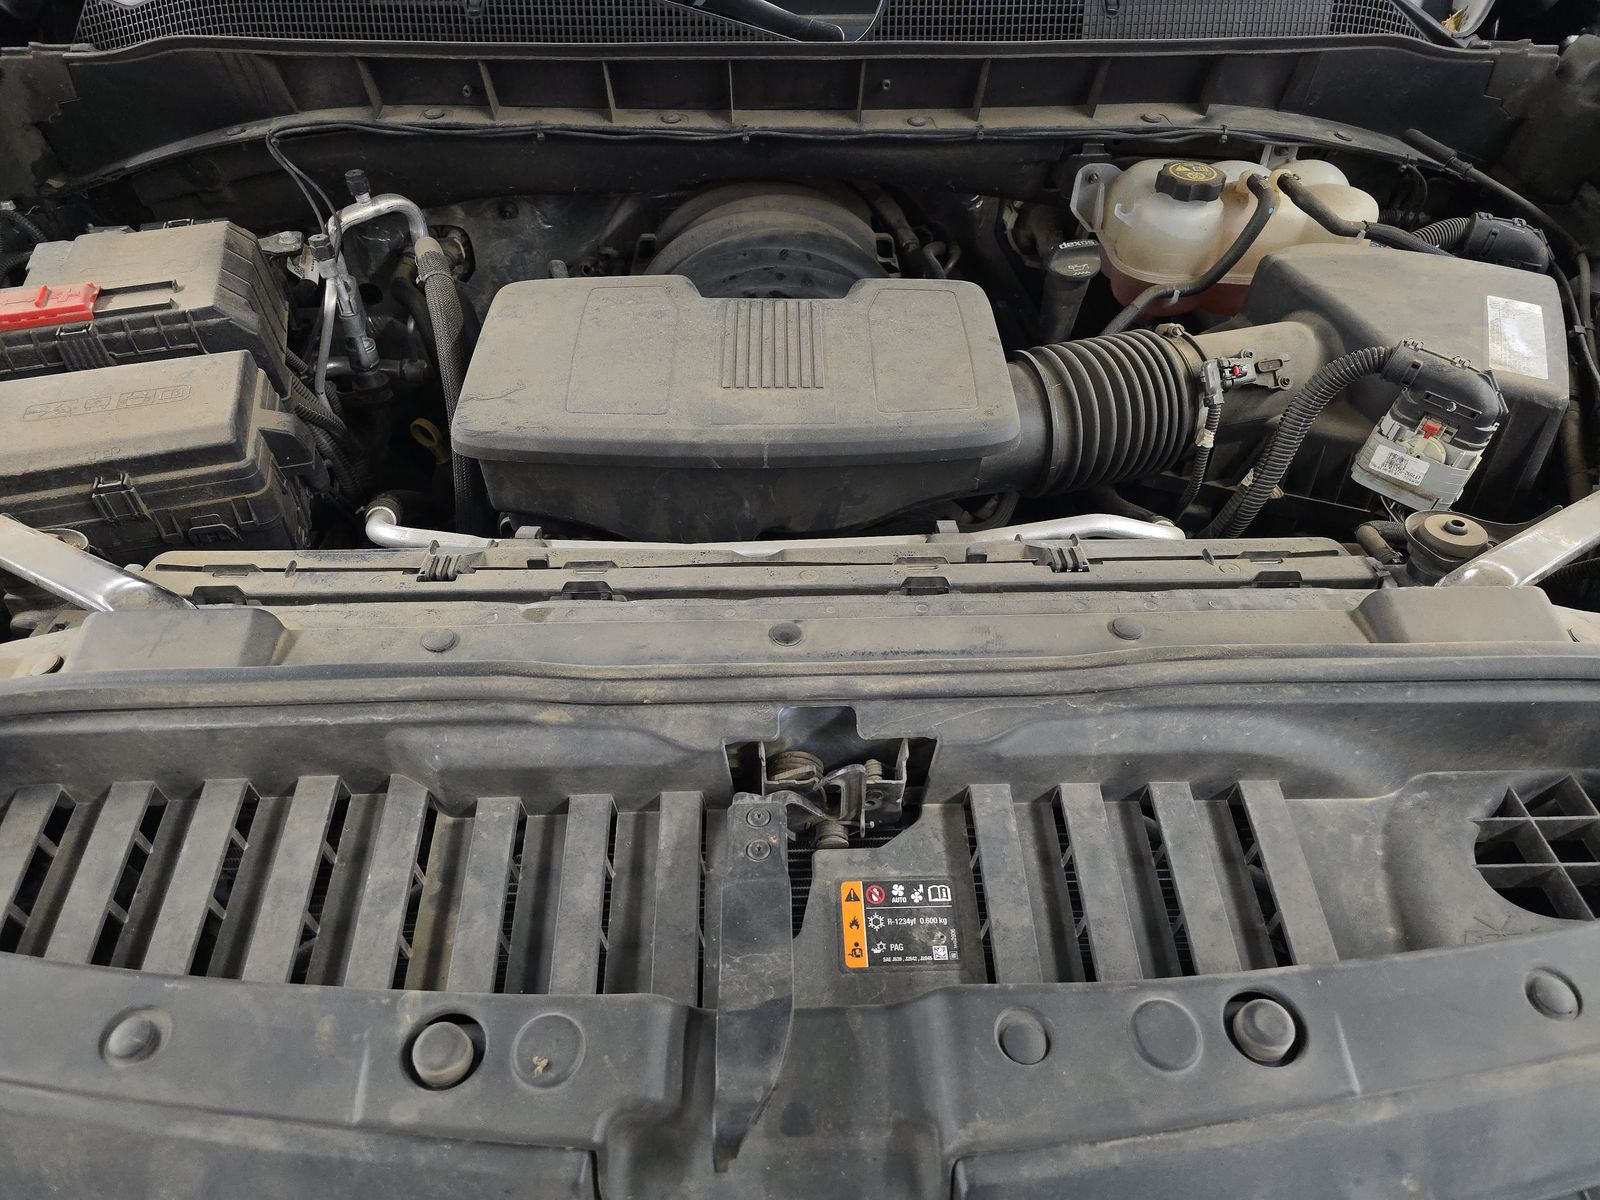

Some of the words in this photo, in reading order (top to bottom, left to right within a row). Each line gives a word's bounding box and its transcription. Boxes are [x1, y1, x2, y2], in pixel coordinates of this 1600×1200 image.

[887, 917, 917, 927] R-1234yf
[919, 916, 938, 925] 0.600
[939, 916, 948, 926] kg
[889, 943, 904, 952] PAG
